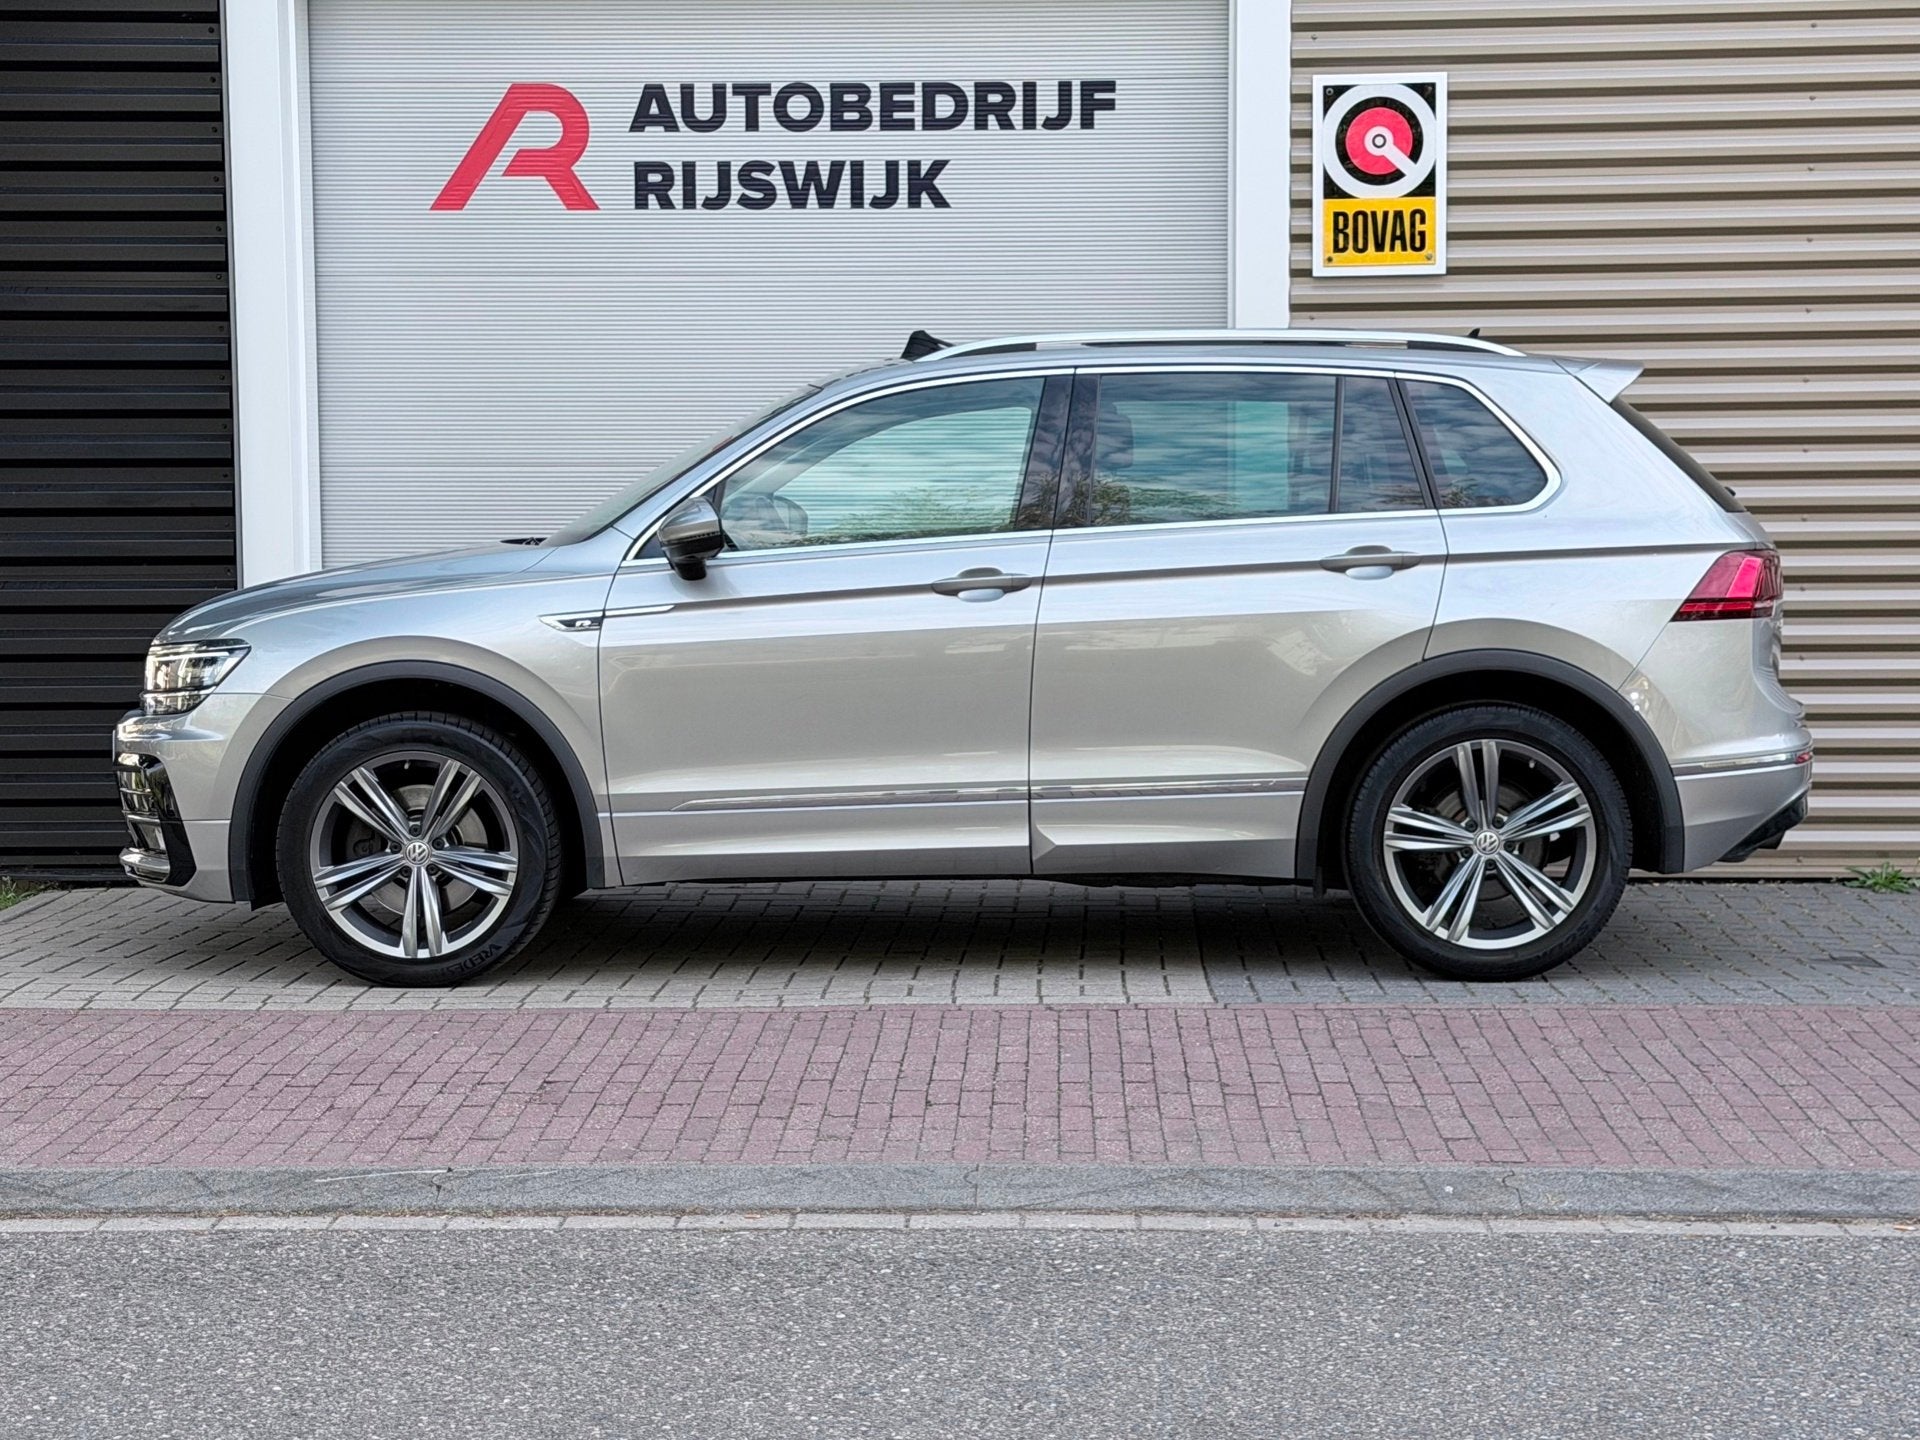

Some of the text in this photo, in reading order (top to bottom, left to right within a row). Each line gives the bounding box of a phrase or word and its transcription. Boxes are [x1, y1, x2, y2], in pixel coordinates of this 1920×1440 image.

[629, 81, 1117, 133] AUTOBEDRIJF
[634, 159, 951, 211] RIJSWIJK
[1332, 208, 1427, 254] BOVAG
